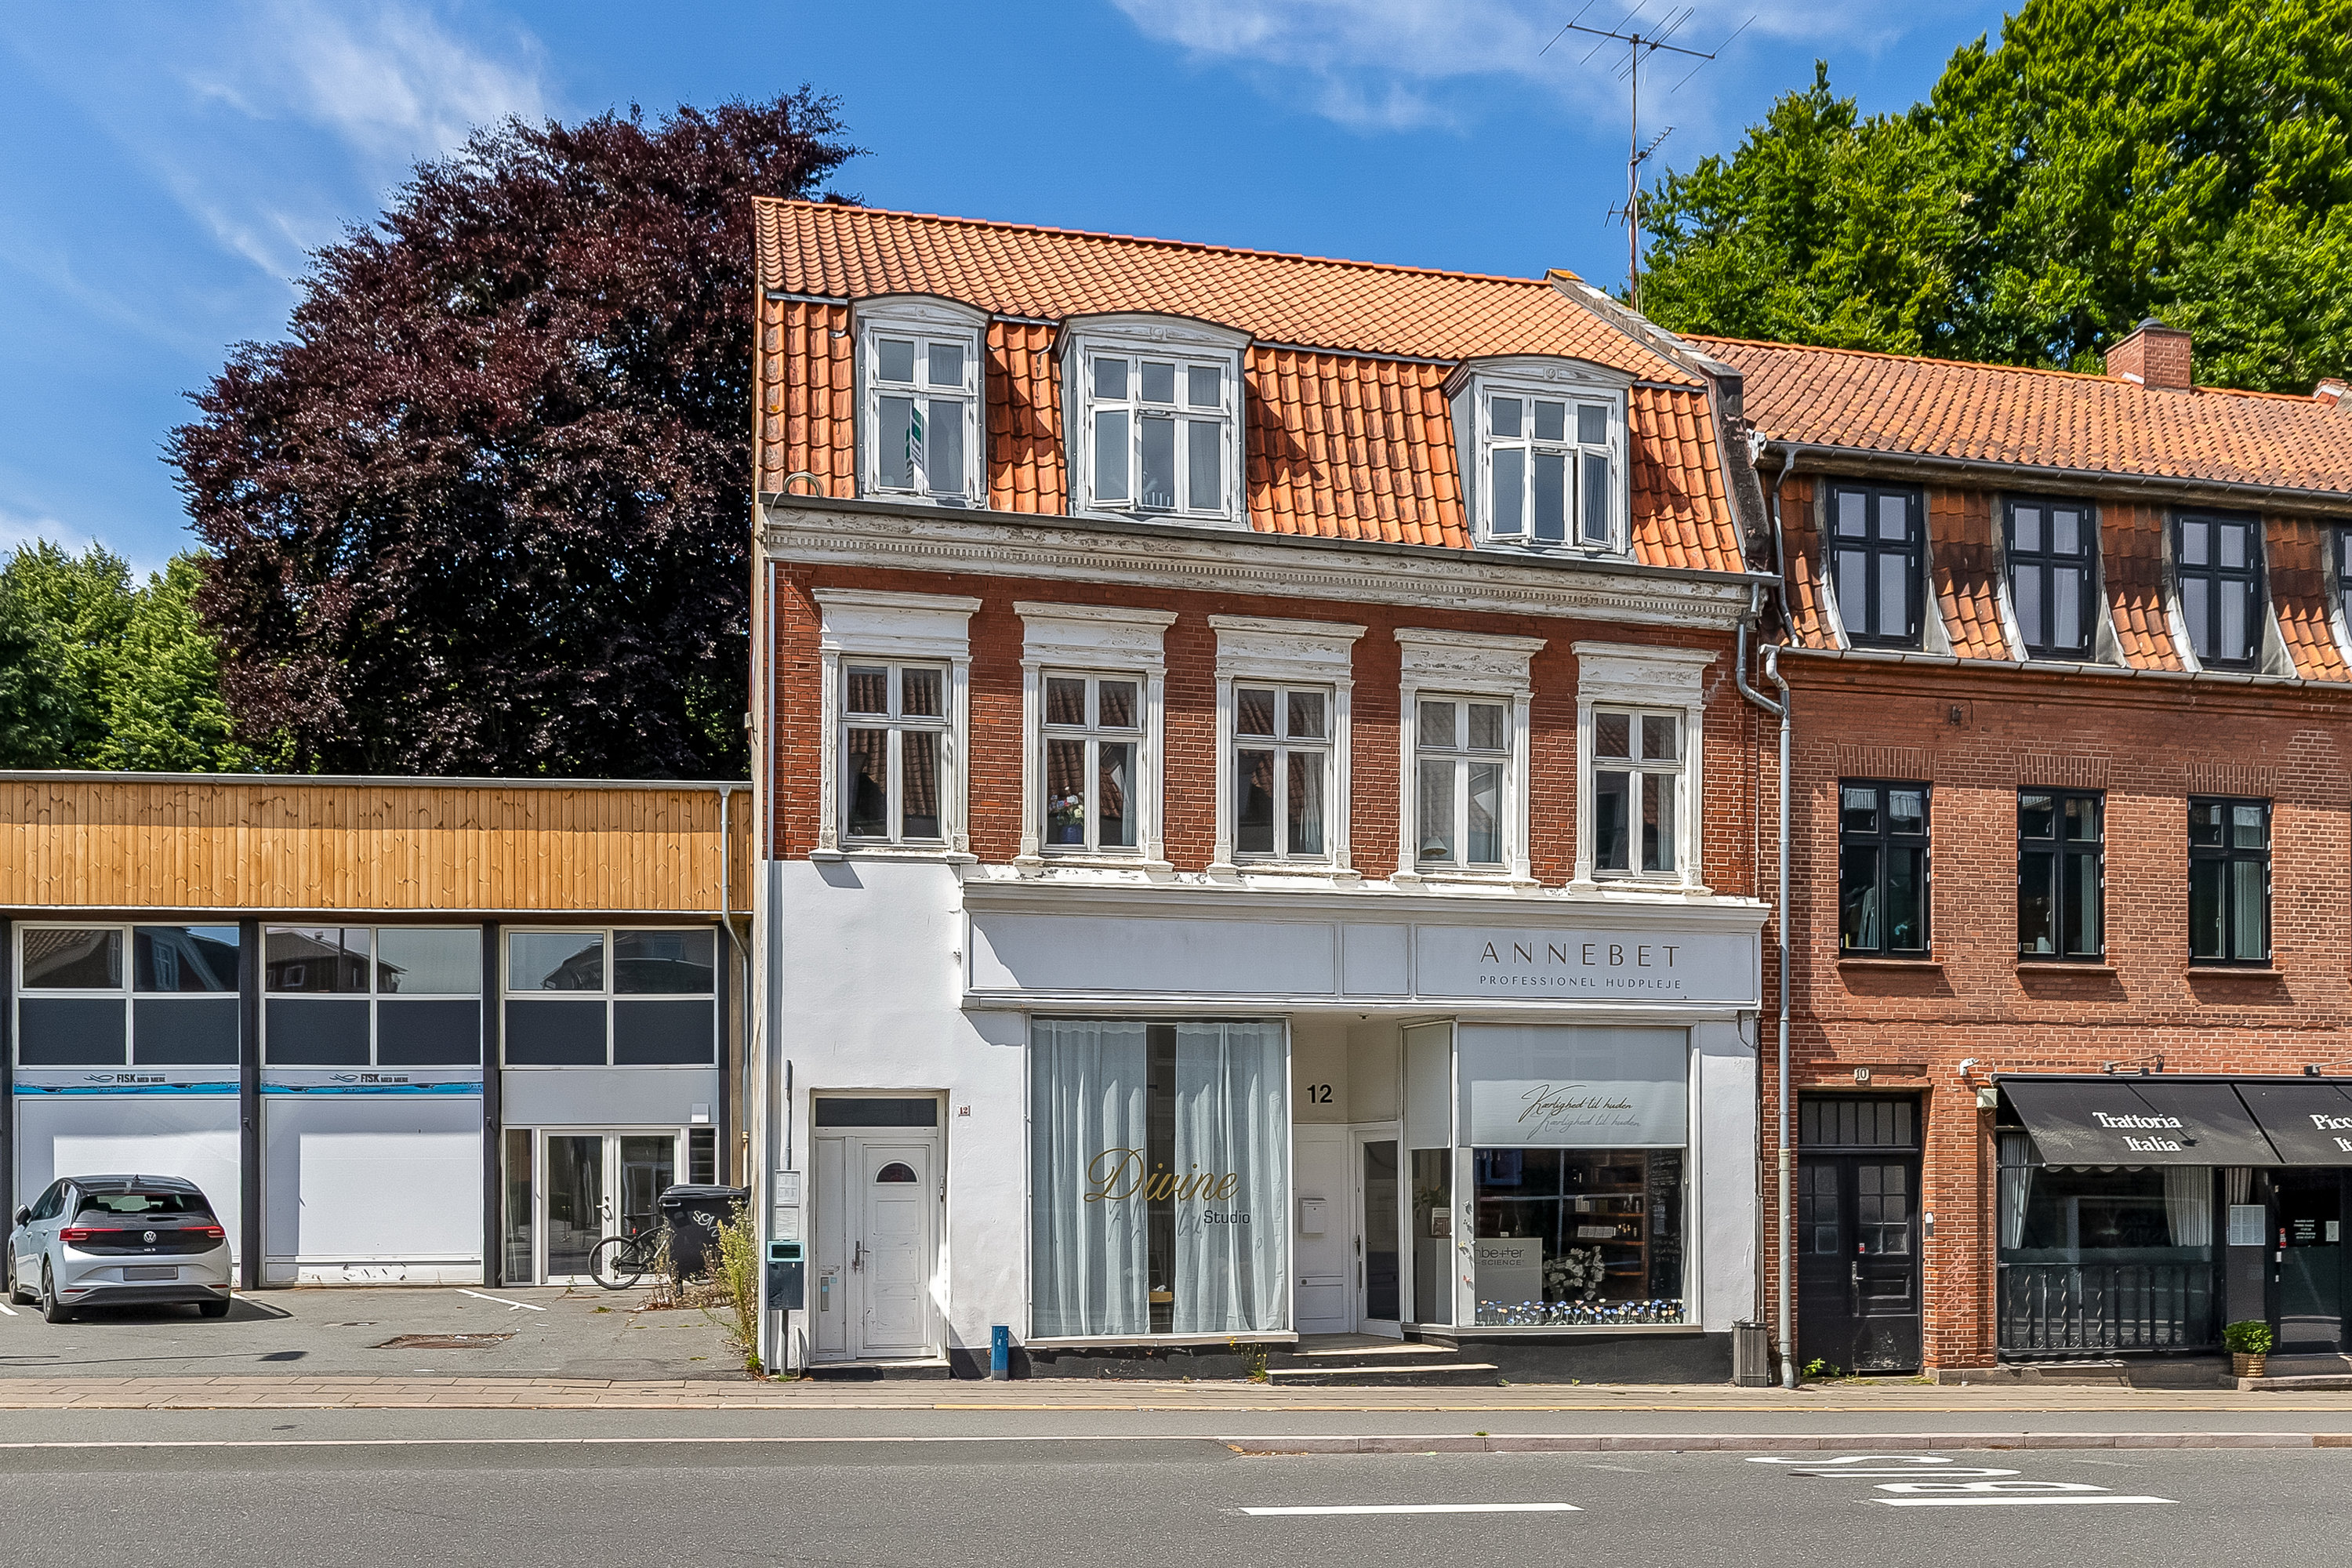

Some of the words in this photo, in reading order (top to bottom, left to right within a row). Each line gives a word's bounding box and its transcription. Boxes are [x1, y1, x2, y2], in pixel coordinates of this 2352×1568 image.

[1480, 941, 1680, 967] ANNEBET
[1479, 975, 1596, 987] PROFESSIONEL
[1606, 978, 1682, 989] HUDPLEJE
[116, 1073, 136, 1083] FISK
[361, 1073, 380, 1083] FISK
[1856, 1069, 1867, 1080] 10
[1307, 1083, 1334, 1104] 12
[960, 1106, 968, 1115] 12
[1518, 1084, 1588, 1123] Kærlighed
[1586, 1097, 1603, 1109] til
[1602, 1097, 1633, 1109] huden
[2092, 1111, 2183, 1129] Trattoria
[2309, 1114, 2352, 1131] Picc
[2122, 1135, 2183, 1152] Italia
[1083, 1147, 1240, 1203] Divine
[1203, 1210, 1251, 1225] Studio
